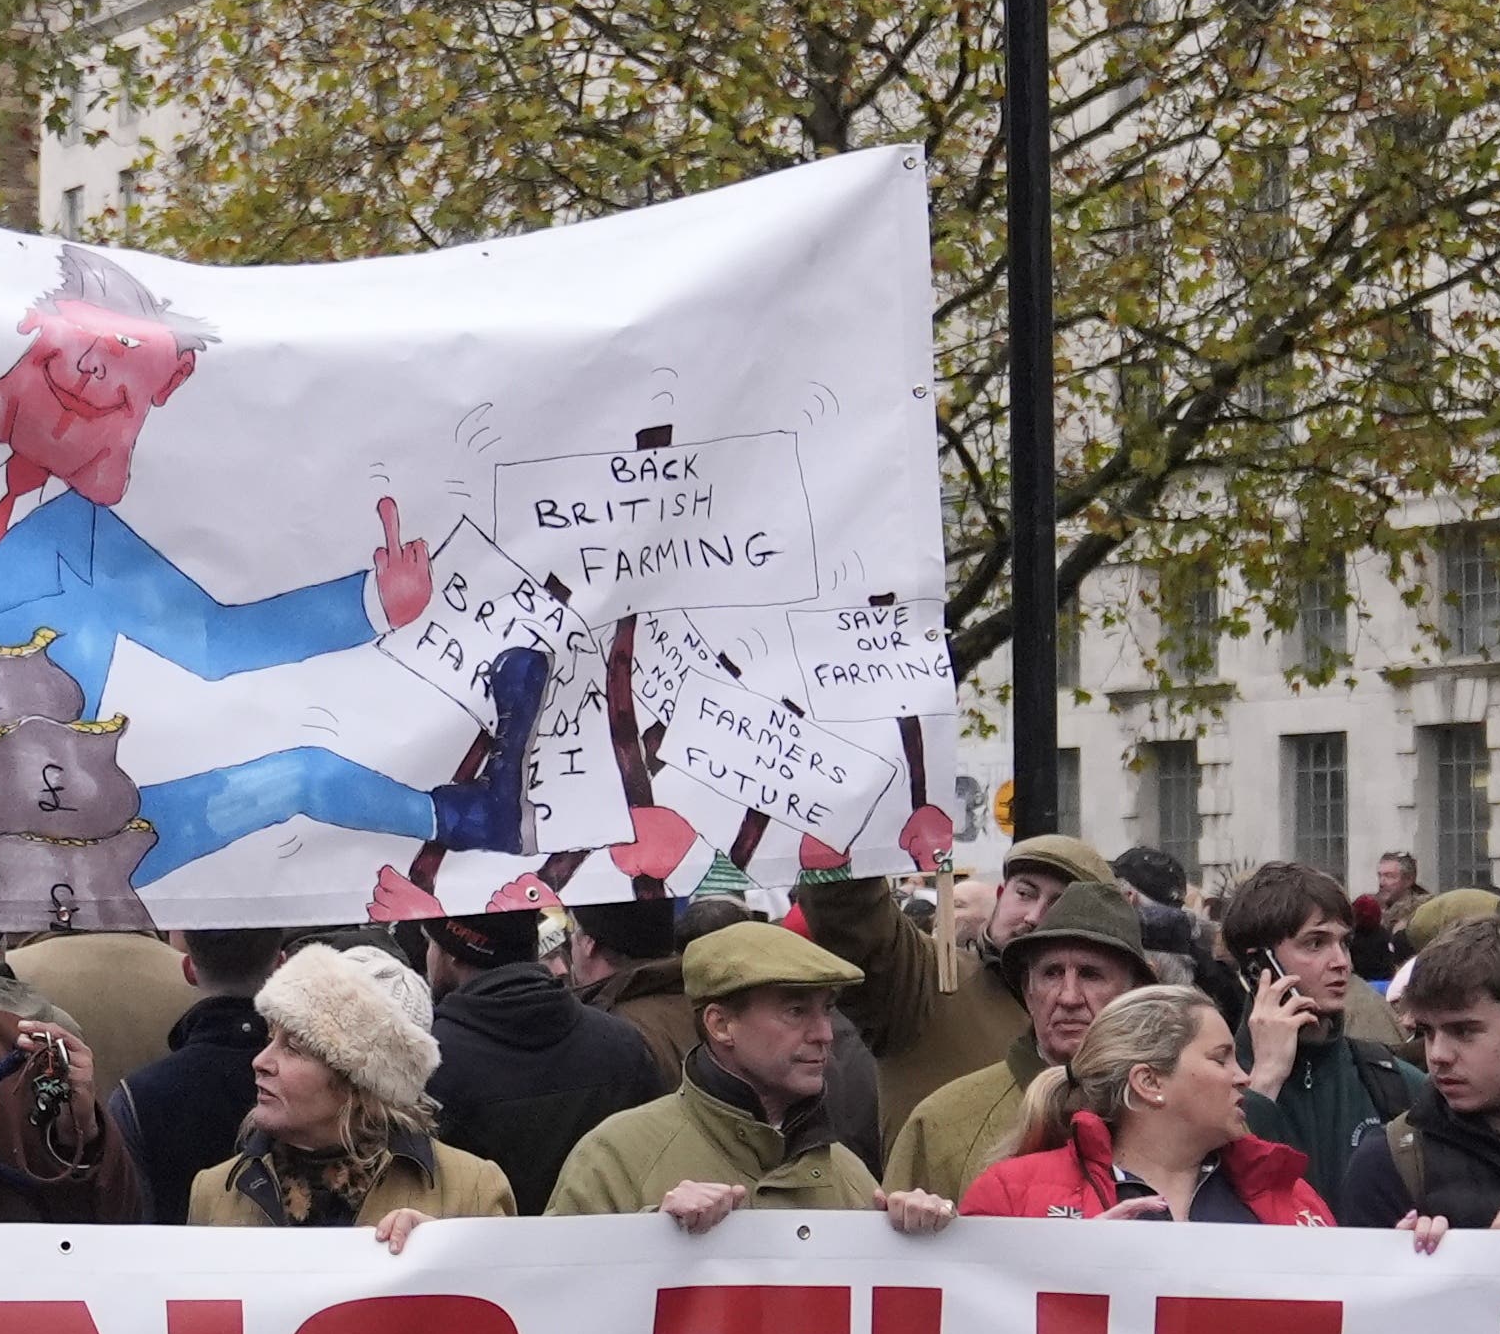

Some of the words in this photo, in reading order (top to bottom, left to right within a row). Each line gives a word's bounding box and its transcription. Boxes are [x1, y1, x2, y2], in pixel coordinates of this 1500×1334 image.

[610, 453, 700, 483] BACK
[535, 484, 713, 529] BRITISH
[580, 531, 784, 585] FARMING
[442, 572, 556, 655] BRIT
[513, 578, 592, 654] BAC
[838, 606, 911, 631] SAVE
[417, 621, 493, 699] FAR
[857, 631, 911, 651] OUR
[814, 654, 952, 688] FARMING
[698, 697, 847, 785] FARMERS
[769, 709, 801, 738] NO
[686, 747, 834, 827] FUTURE
[755, 754, 794, 780] NO
